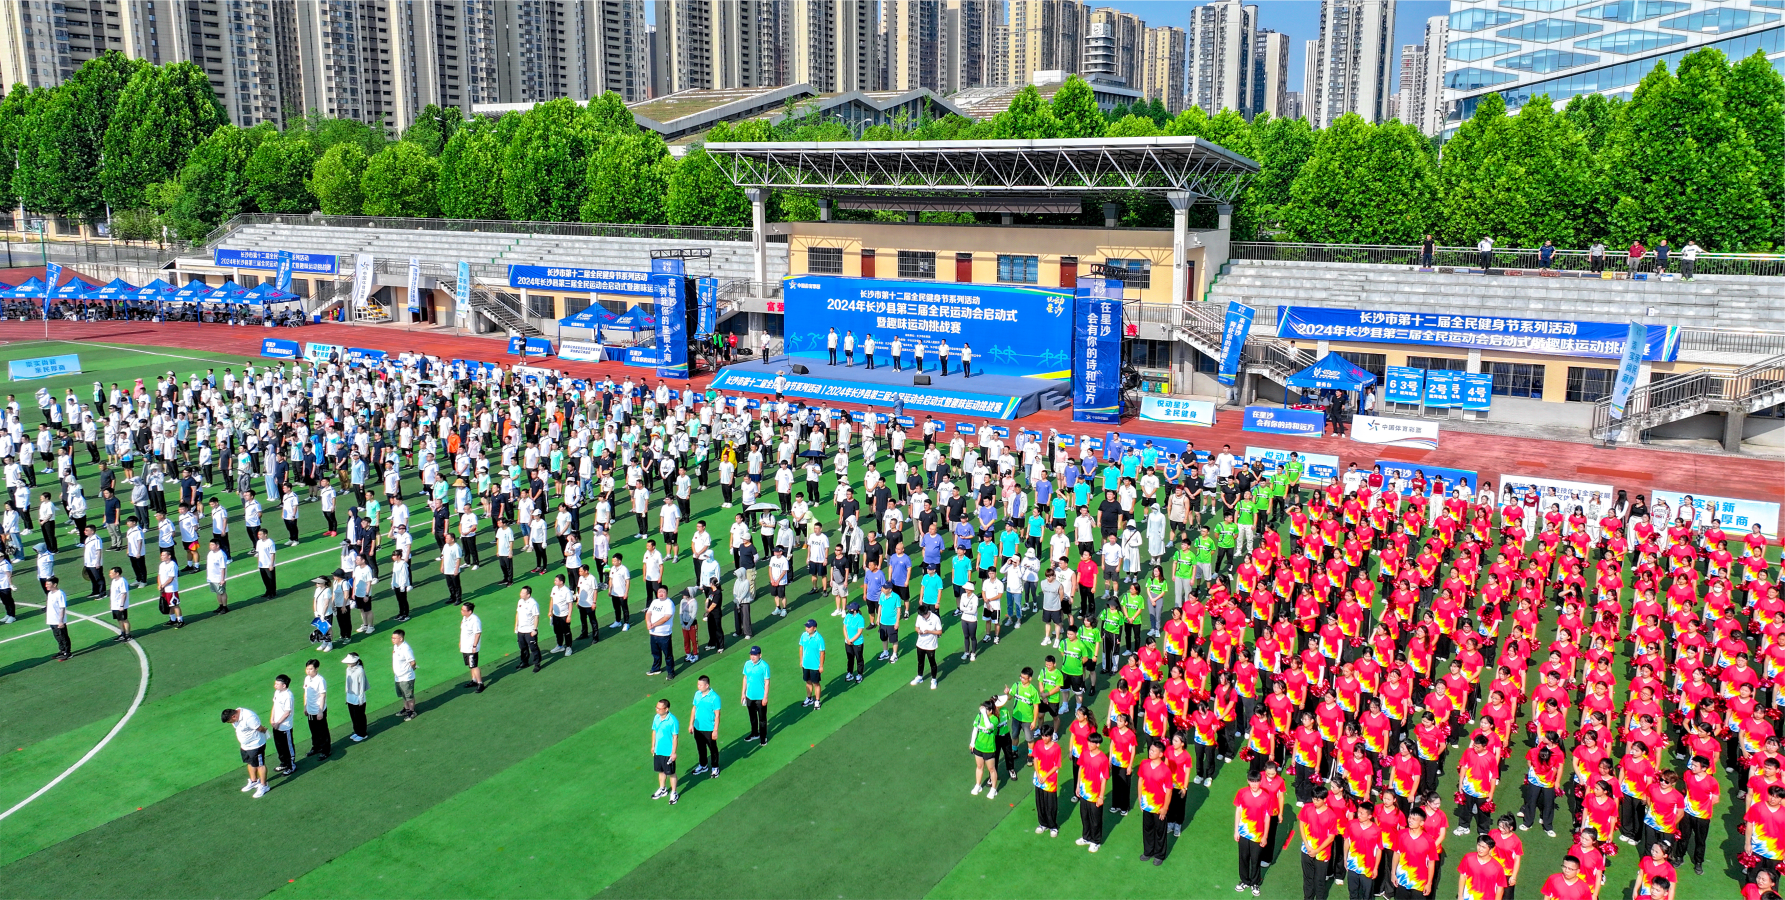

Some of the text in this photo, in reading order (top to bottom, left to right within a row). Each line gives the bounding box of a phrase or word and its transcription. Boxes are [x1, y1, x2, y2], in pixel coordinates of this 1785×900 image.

[547, 268, 648, 282] 长沙市第十二届全民健身节系列活动
[860, 289, 981, 305] 长沙市第十二届全民健身节系列活动
[827, 298, 1018, 322] 2024年长沙县第三届全民运动会启动式
[876, 316, 962, 334] 暨趣味运动挑战赛
[1100, 301, 1112, 336] 在星沙
[1360, 311, 1578, 335] 长沙市第十二届全民健身节系列活动
[1085, 312, 1098, 404] 会有你的诗和远方
[1400, 381, 1418, 391] 3号
[1429, 384, 1447, 394] 2号
[1467, 387, 1487, 398] 4号
[1157, 399, 1190, 409] 悦动星沙
[1164, 408, 1197, 419] 全民健身
[1252, 410, 1275, 420] 在星沙
[1256, 419, 1316, 432] 会有你的诗和远方
